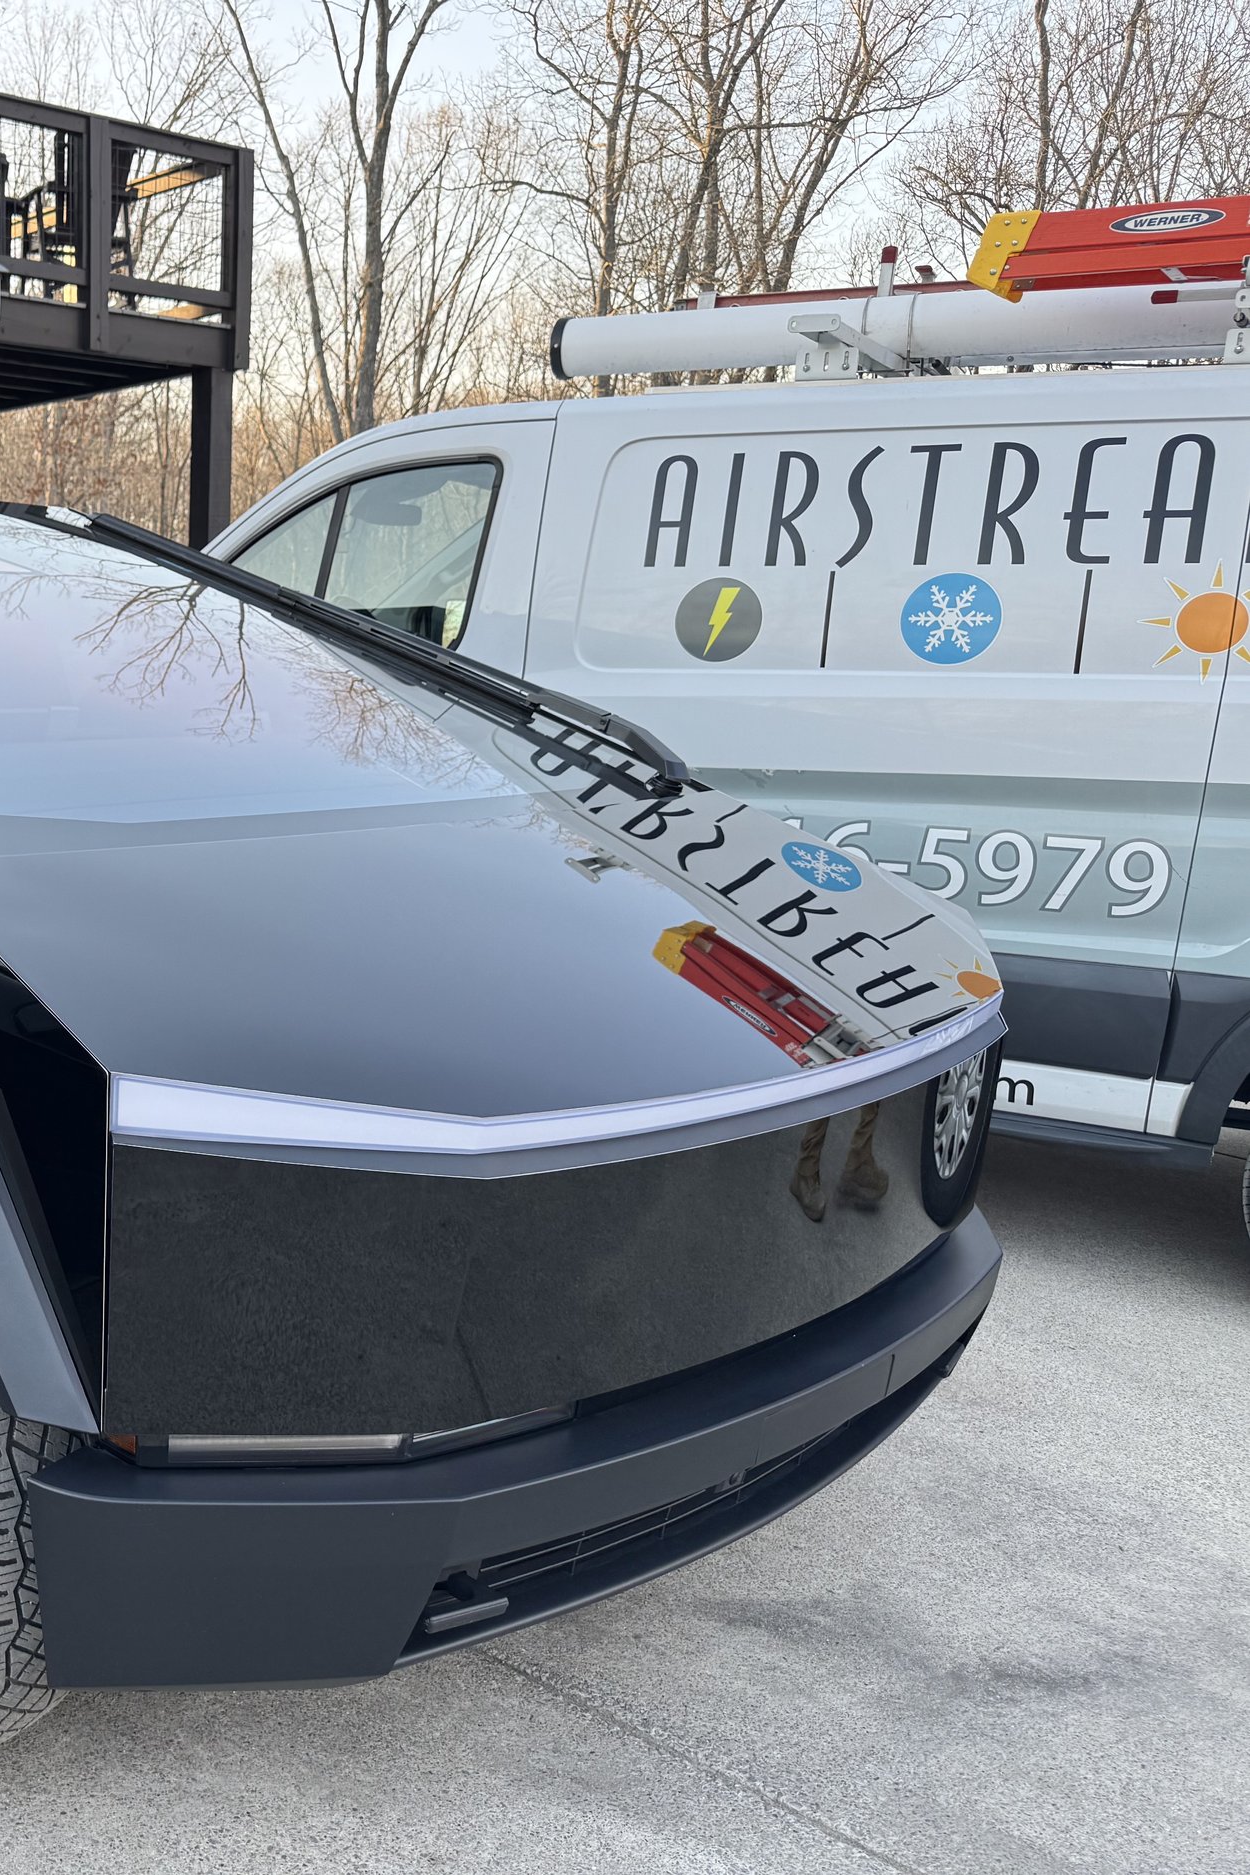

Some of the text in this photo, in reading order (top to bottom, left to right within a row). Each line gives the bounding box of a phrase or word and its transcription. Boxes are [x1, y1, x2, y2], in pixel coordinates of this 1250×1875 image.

[1133, 213, 1203, 228] WERNER
[644, 433, 1250, 568] AIRSTREA
[781, 816, 1172, 917] 6-5979
